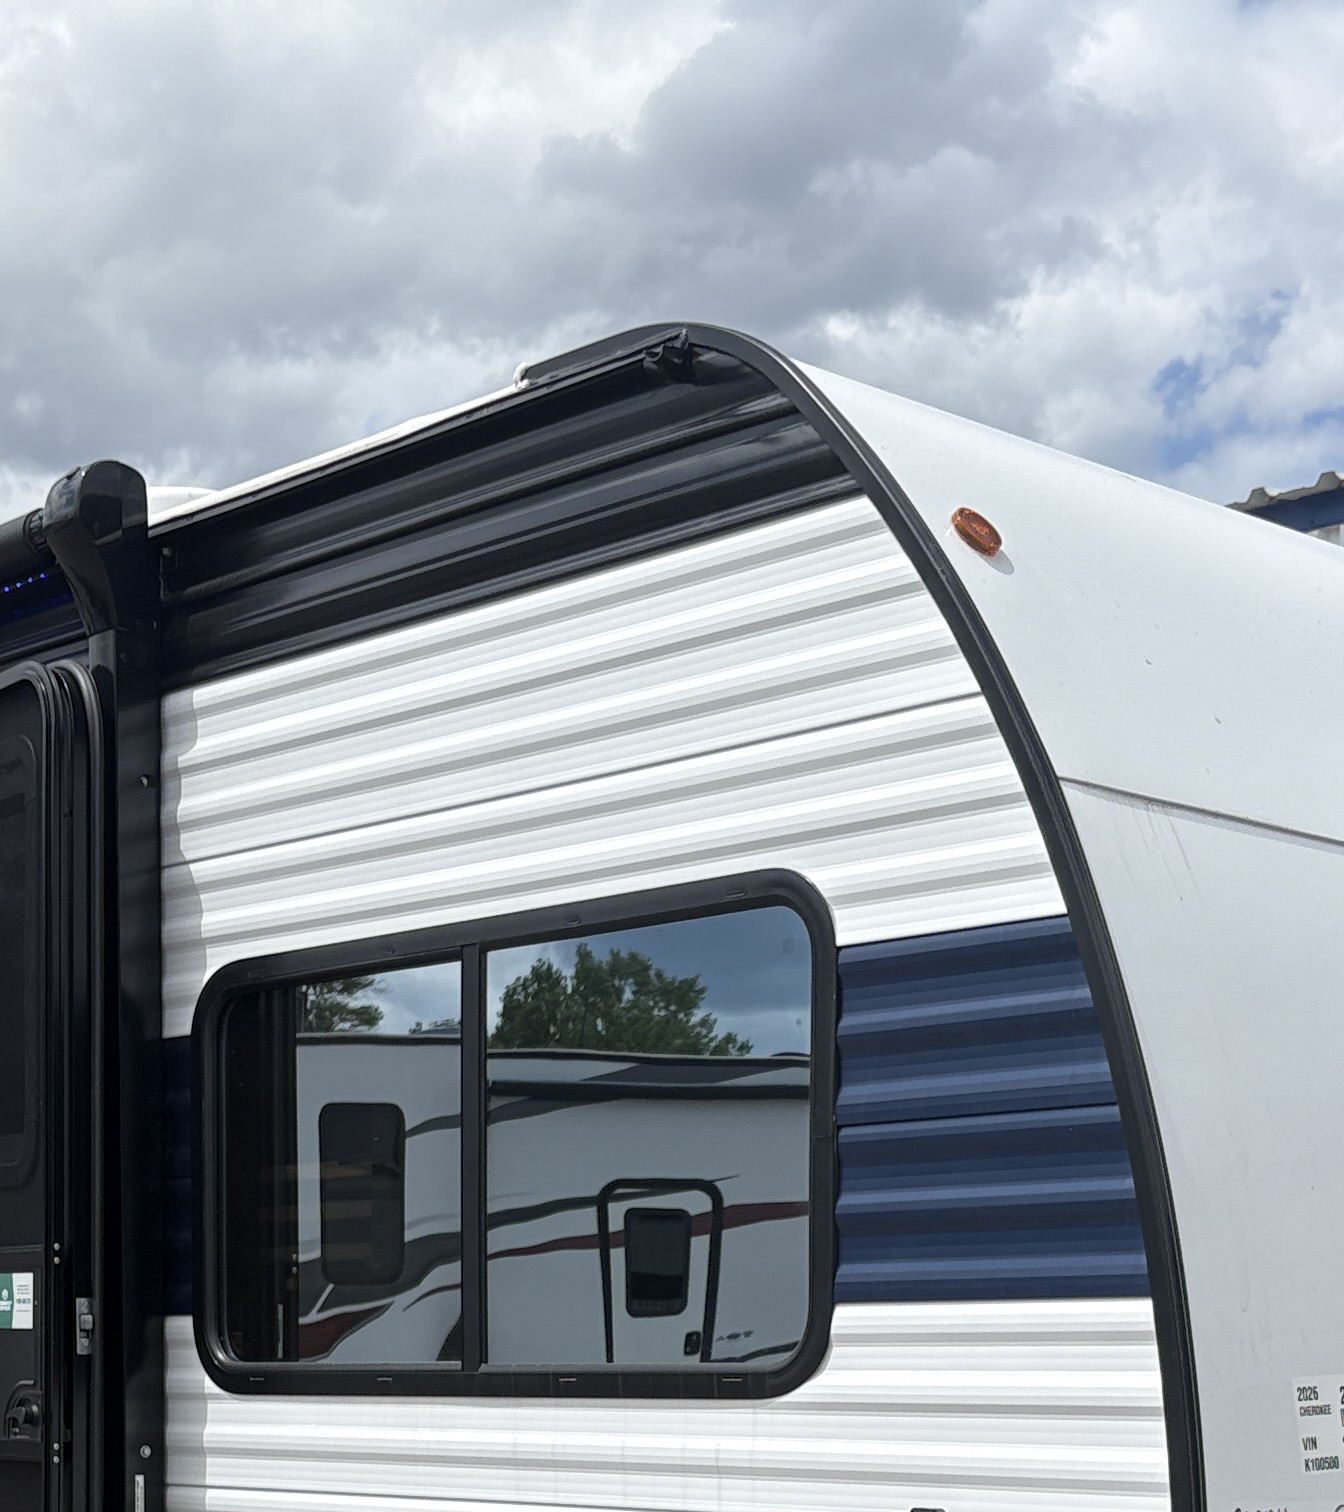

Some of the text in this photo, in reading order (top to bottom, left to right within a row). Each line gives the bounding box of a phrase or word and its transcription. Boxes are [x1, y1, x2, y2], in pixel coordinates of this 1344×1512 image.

[1297, 1386, 1319, 1401] 2026
[1302, 1436, 1317, 1451] VIN
[1304, 1455, 1339, 1472] K100500
